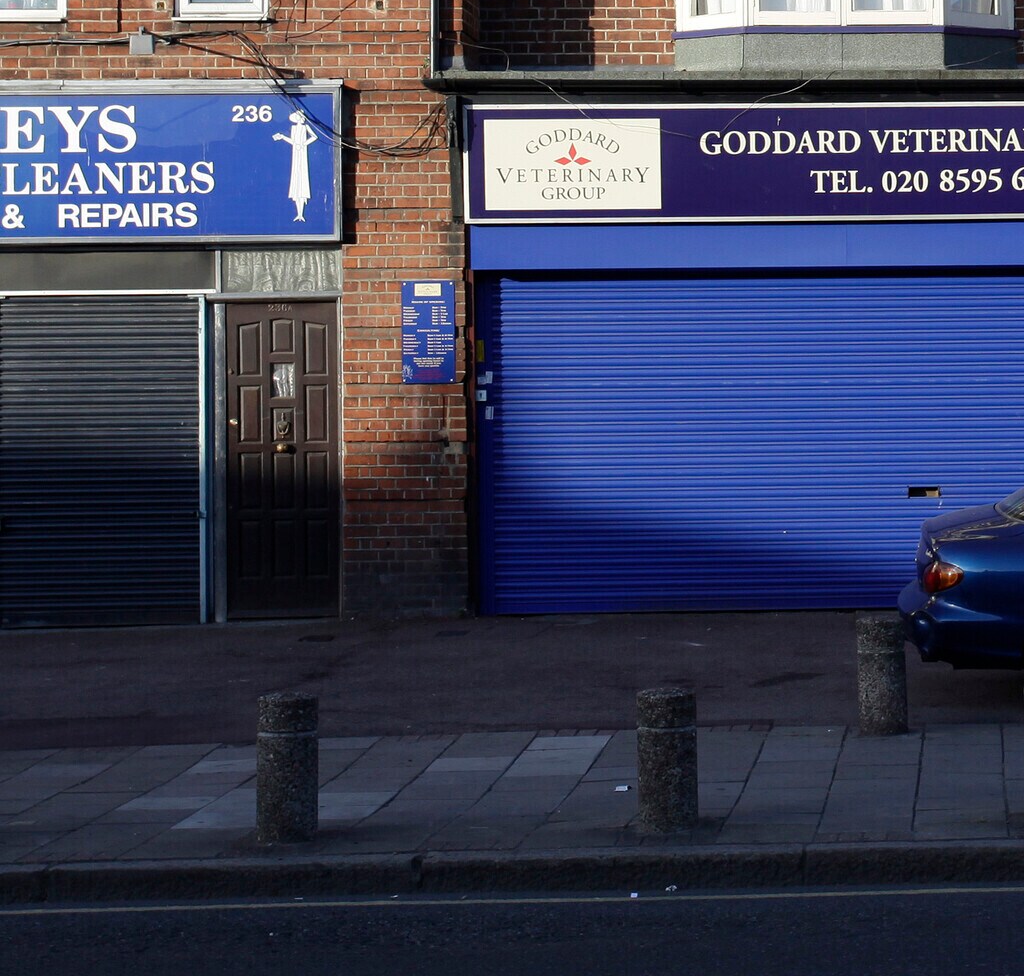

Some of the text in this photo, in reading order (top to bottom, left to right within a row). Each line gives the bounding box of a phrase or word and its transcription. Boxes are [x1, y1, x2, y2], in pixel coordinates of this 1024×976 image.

[231, 105, 273, 123] 236
[0, 105, 138, 154] EYS
[525, 127, 621, 155] GODDARD
[699, 129, 862, 156] GODDARD
[2, 161, 216, 196] LEANERS
[495, 166, 650, 185] VETERINARY
[810, 170, 873, 194] TEL.
[882, 170, 928, 194] 020
[939, 167, 1002, 194] 8595
[541, 186, 606, 201] GROUP
[1, 201, 198, 229] & REPAIRS
